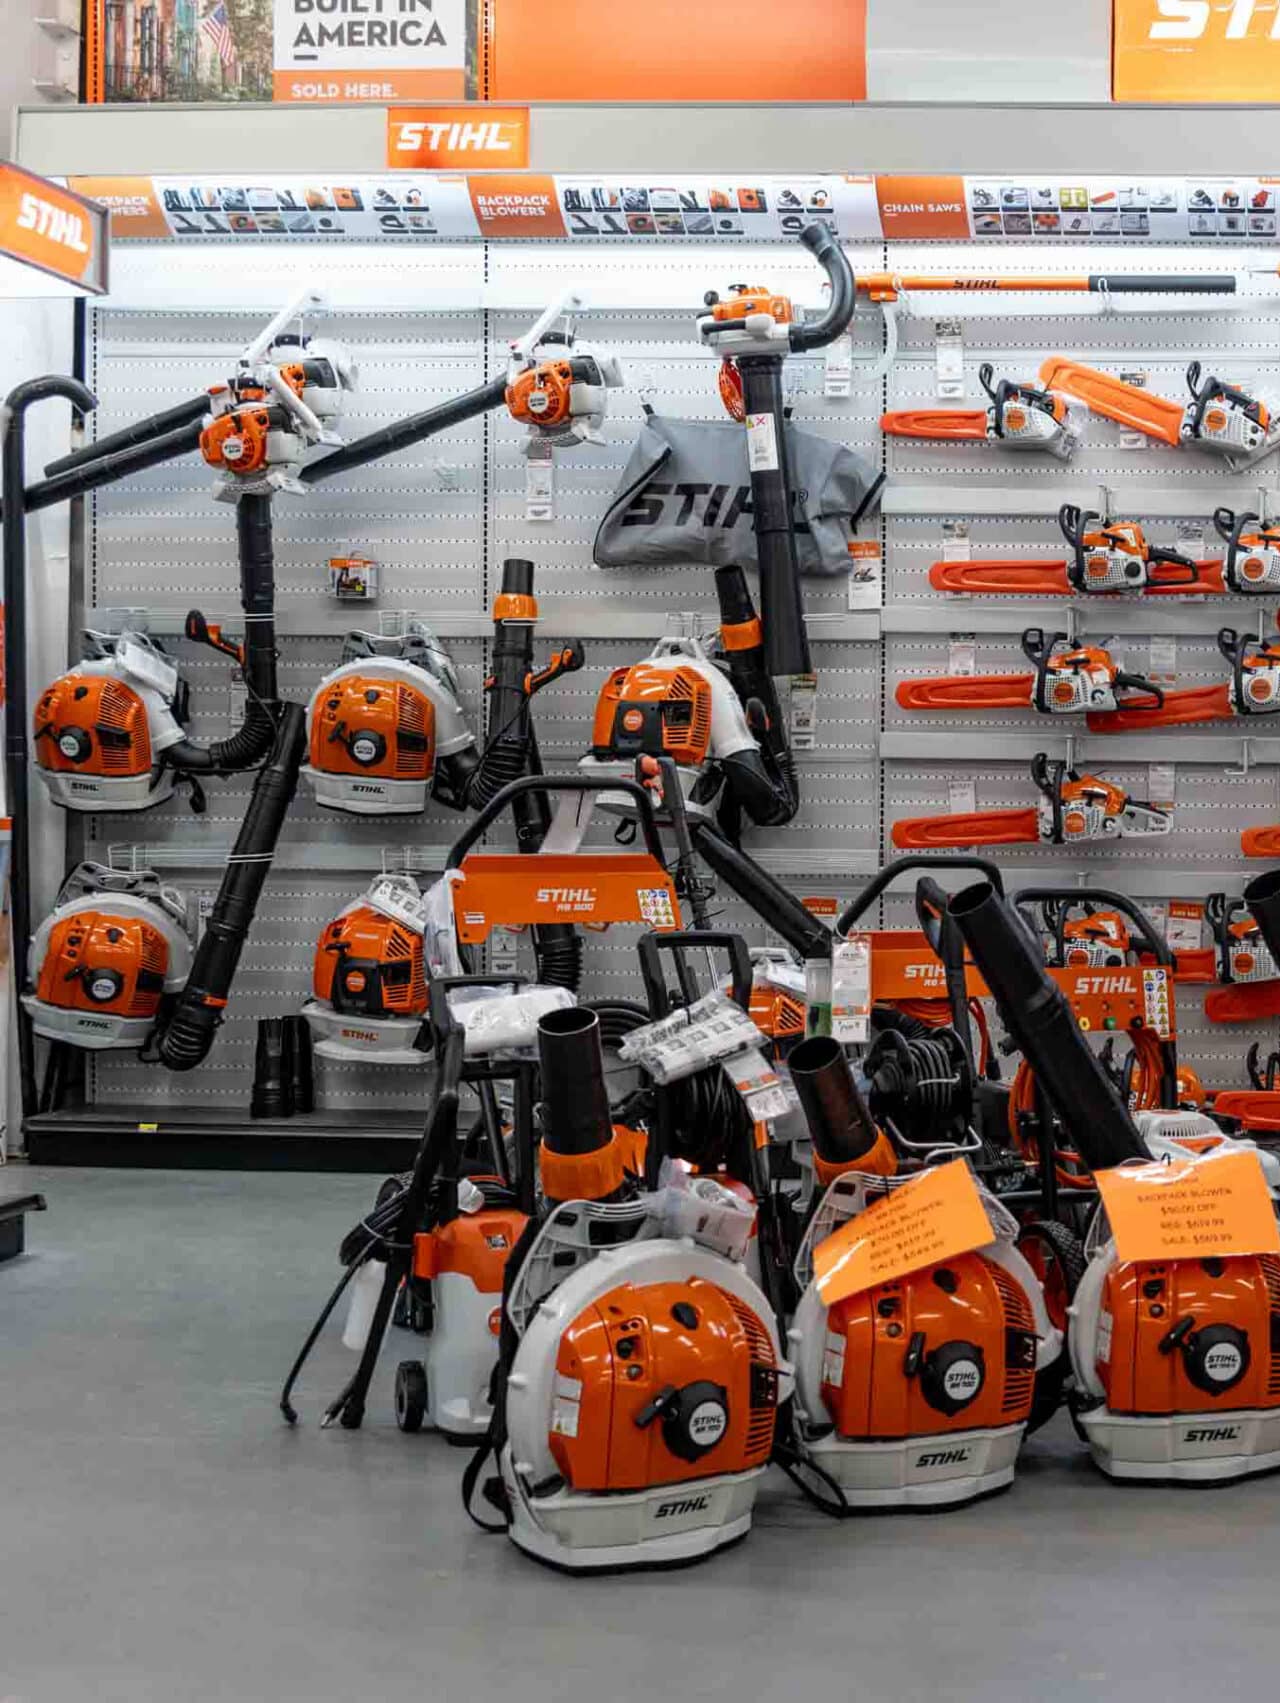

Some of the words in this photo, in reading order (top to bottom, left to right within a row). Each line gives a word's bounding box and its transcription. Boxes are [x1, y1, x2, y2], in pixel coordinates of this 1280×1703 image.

[293, 20, 447, 47] AMERICA
[291, 83, 339, 98] SOLD
[345, 83, 398, 98] HERE.
[397, 122, 511, 151] STIHL
[90, 196, 150, 207] CKPACK
[477, 195, 550, 206] BACKPACK
[480, 206, 546, 217] BLOWERS
[883, 203, 924, 213] CHAIN
[927, 203, 962, 213] SAWS
[16, 193, 88, 253] STIHL
[71, 781, 100, 792] STIHL
[352, 784, 386, 794] STIHL
[536, 887, 597, 902] STIHL
[904, 963, 946, 980] STIH
[1075, 975, 1137, 995] STIHL
[77, 1018, 113, 1030] STIHL
[341, 1028, 380, 1042] STIHL
[1207, 1355, 1238, 1364] STIHL
[947, 1371, 977, 1382] STIHL
[692, 1415, 723, 1427] STIHL
[1184, 1427, 1239, 1443] STIHL
[916, 1448, 969, 1468] STIHL
[655, 1497, 709, 1518] STIHL
